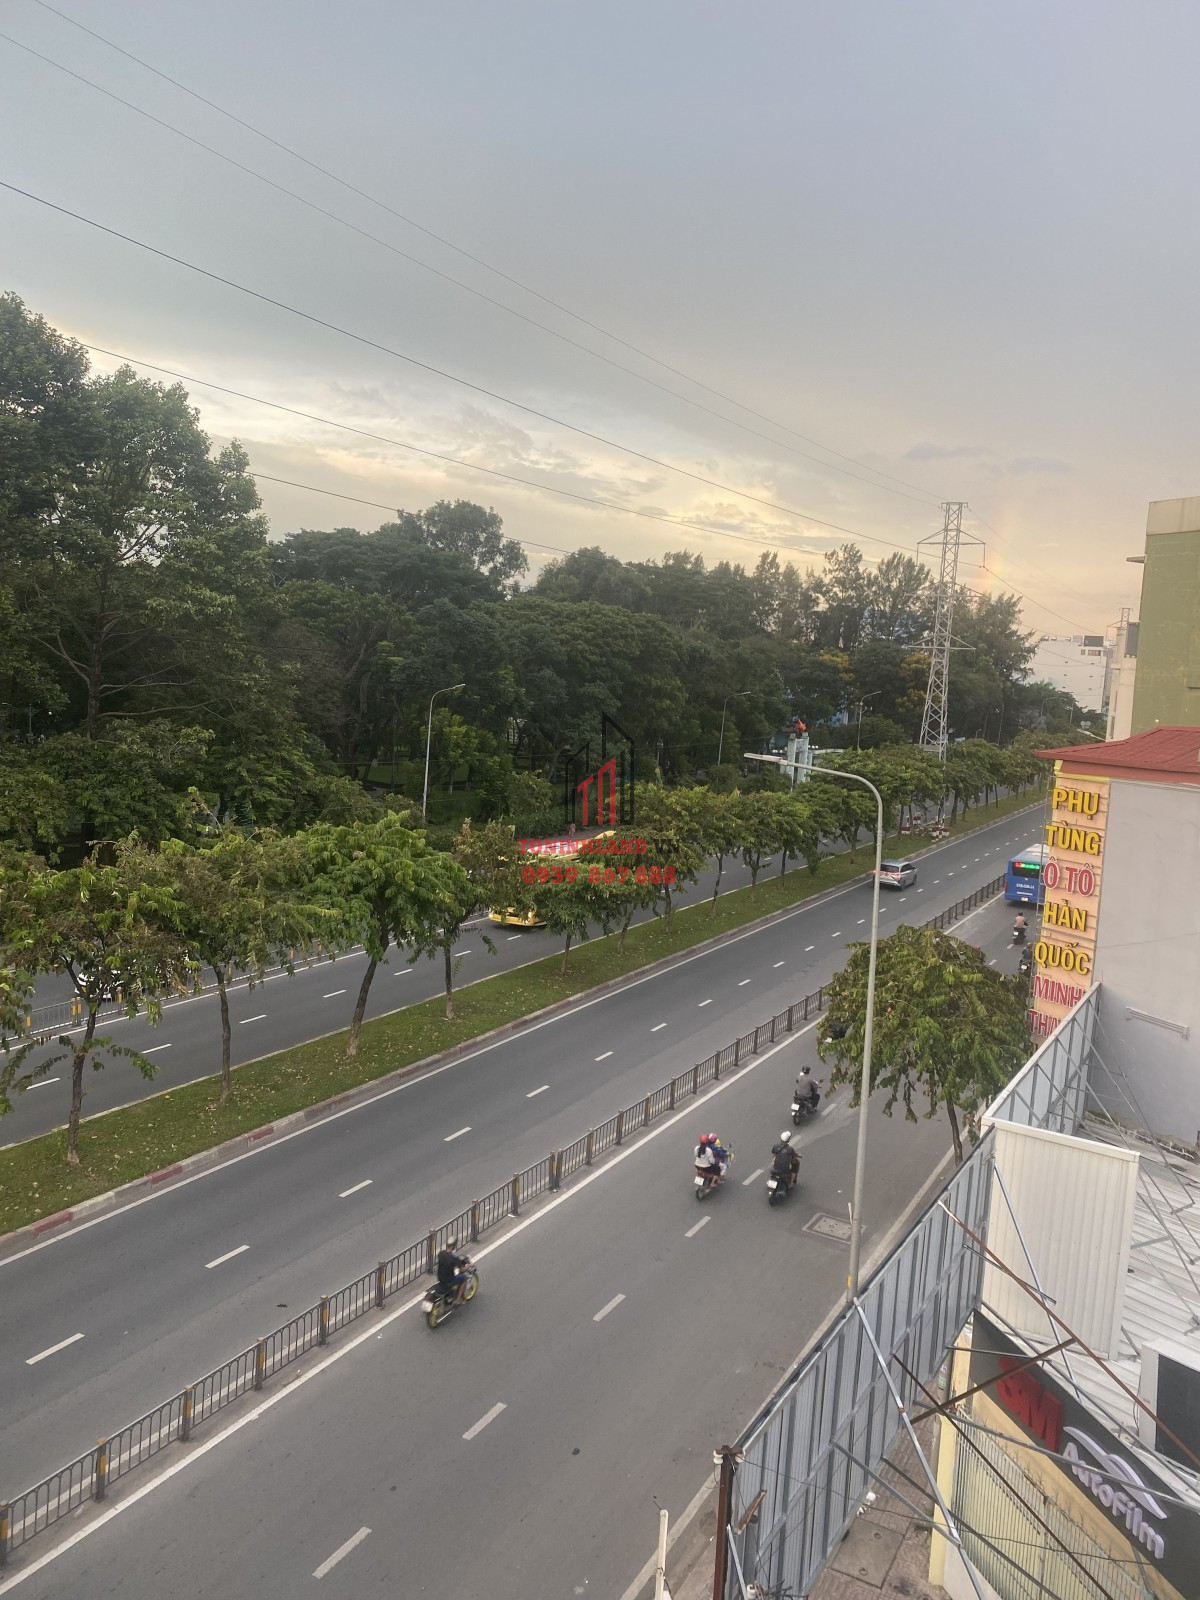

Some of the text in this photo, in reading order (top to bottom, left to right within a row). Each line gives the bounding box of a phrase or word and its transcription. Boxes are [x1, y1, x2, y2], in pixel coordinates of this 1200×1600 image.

[1052, 788, 1099, 820] PHỤ
[1046, 820, 1100, 856] TÙNG
[1044, 856, 1093, 896] Ô TÔ
[1044, 898, 1088, 932] HÀN
[1034, 941, 1091, 975] QUỐC
[1032, 975, 1083, 1008] MINH
